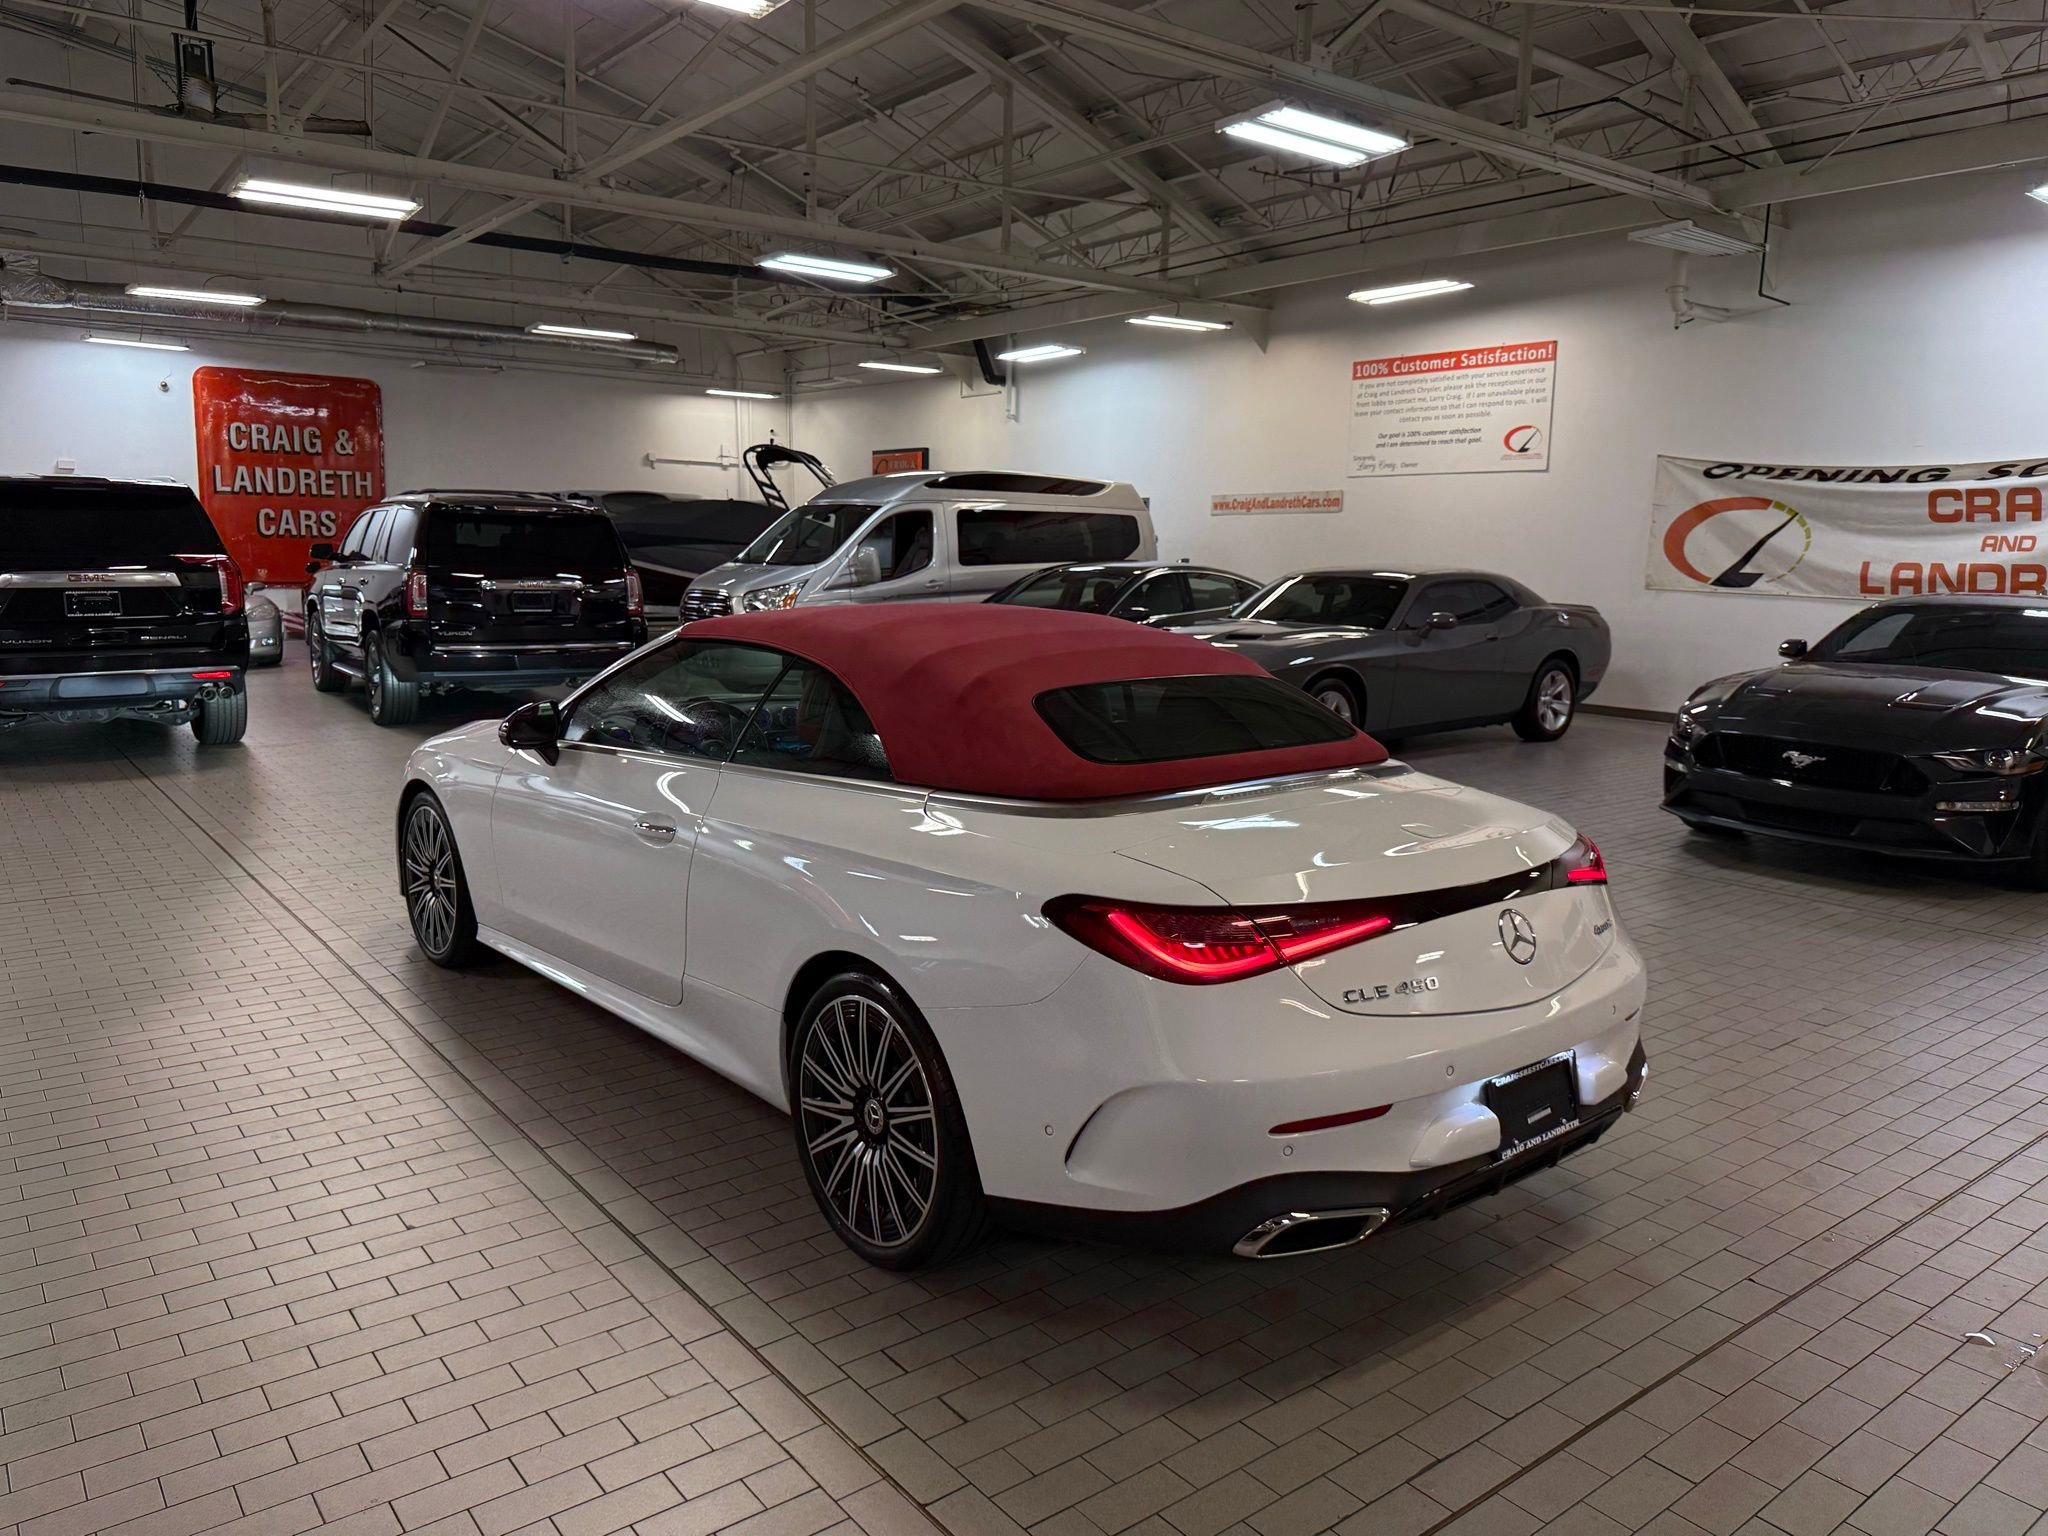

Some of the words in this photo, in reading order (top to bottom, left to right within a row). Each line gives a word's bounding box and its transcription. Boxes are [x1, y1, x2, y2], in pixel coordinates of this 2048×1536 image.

[1355, 362, 1389, 377] 100%
[1392, 357, 1457, 373] Customer
[1461, 344, 1553, 367] Satisfaction!
[1430, 375, 1454, 383] satisfied
[1487, 370, 1508, 378] service
[1510, 367, 1545, 376] experience
[1444, 384, 1463, 392] please
[1488, 379, 1526, 387] receptionist
[1488, 389, 1523, 397] unavailable
[1525, 387, 1546, 395] please
[1405, 405, 1439, 413] information
[1479, 400, 1504, 408] respond
[229, 421, 322, 453] CRAIG
[334, 428, 354, 455] &
[1449, 427, 1481, 435] satisfaction
[213, 465, 373, 497] LANDRETH
[1702, 463, 1951, 484] OPENING
[1928, 487, 2043, 523] CRA
[257, 508, 337, 537] CARS
[1980, 535, 2038, 552] AND
[67, 572, 116, 583] GMC
[1859, 561, 2048, 595] LANDR
[1343, 985, 1390, 1003] CLE
[1395, 976, 1439, 995] 450
[1501, 1143, 1525, 1160] CRAIG
[1526, 1134, 1542, 1149] AND
[1542, 1118, 1580, 1141] LANDRETH
